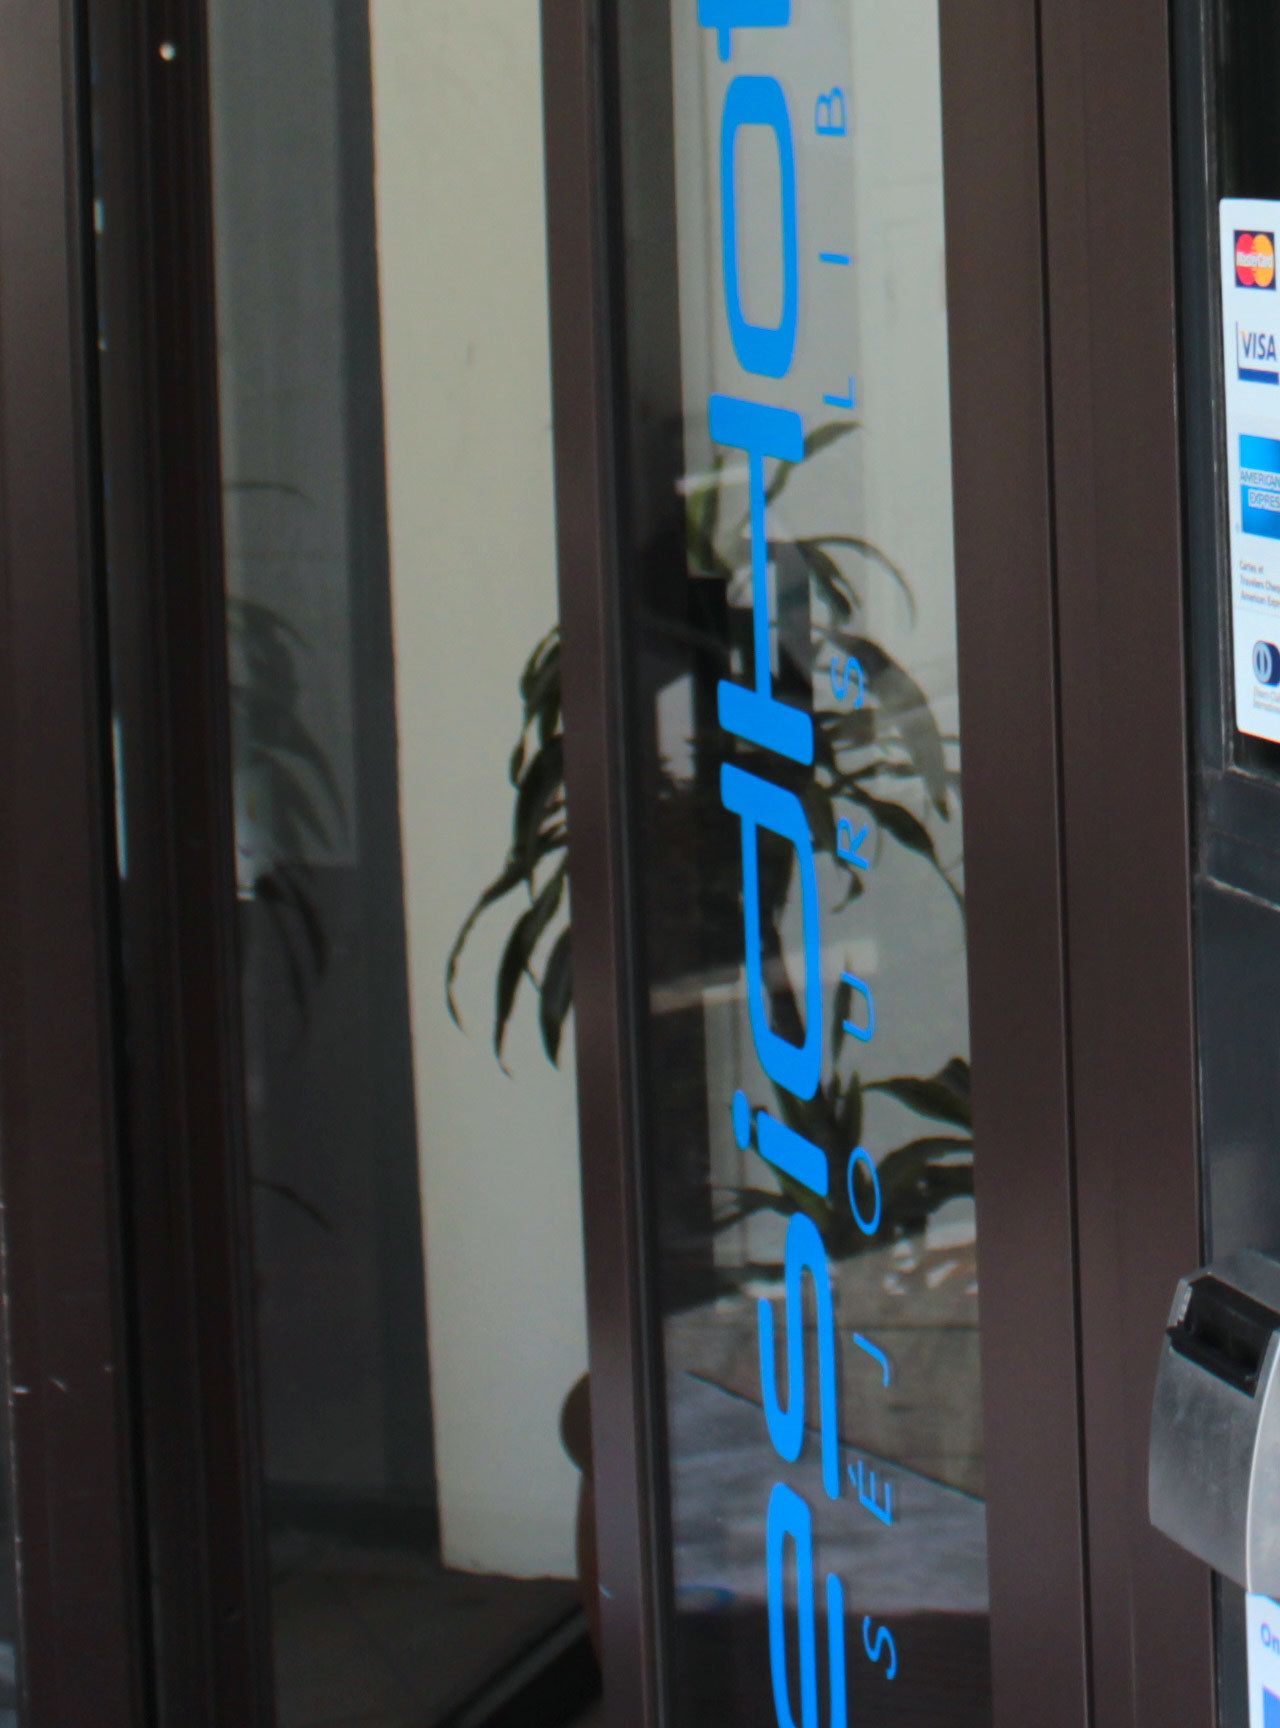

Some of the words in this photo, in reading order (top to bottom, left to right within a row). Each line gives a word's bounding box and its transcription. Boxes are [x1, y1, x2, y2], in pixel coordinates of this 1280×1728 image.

[1239, 331, 1278, 362] VISA
[833, 653, 898, 1681] SÉJOURS
[1259, 1621, 1280, 1654] On
